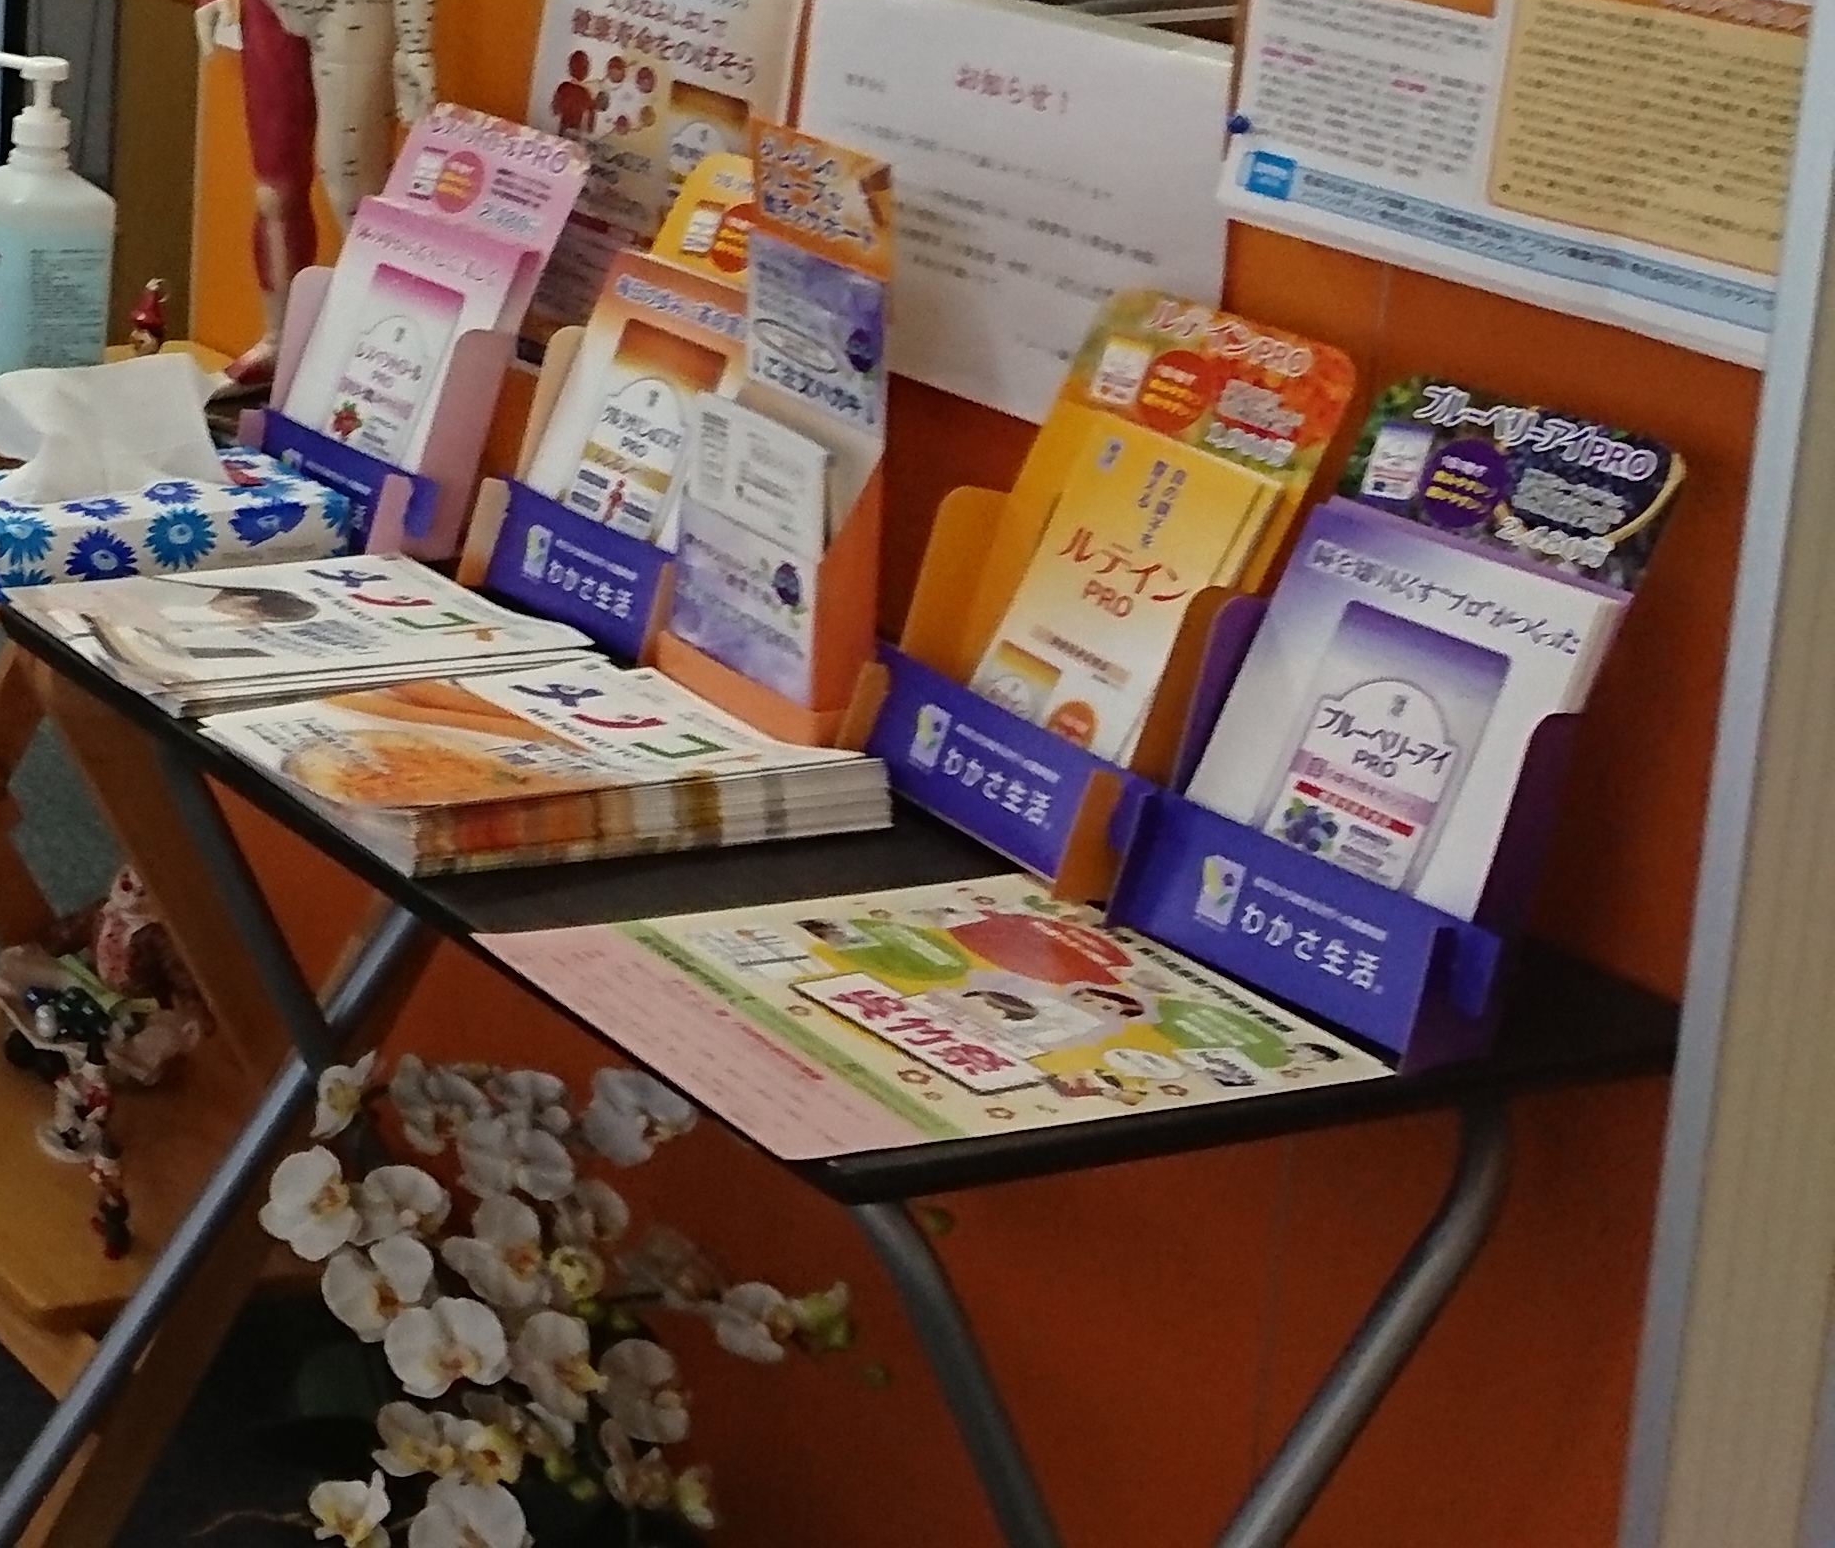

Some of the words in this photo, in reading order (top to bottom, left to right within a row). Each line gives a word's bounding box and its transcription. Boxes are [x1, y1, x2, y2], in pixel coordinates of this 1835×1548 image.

[1411, 384, 1661, 482] ブルーベリーアイPRO
[546, 558, 635, 621] わかさ生活
[1059, 526, 1188, 603] ルテイン
[1083, 579, 1134, 619] PRO
[1315, 706, 1453, 776] ブルーベリーアイ
[1351, 748, 1399, 779] PRO
[943, 746, 1054, 827] わかさ生活
[1240, 901, 1382, 991] わかさ生活
